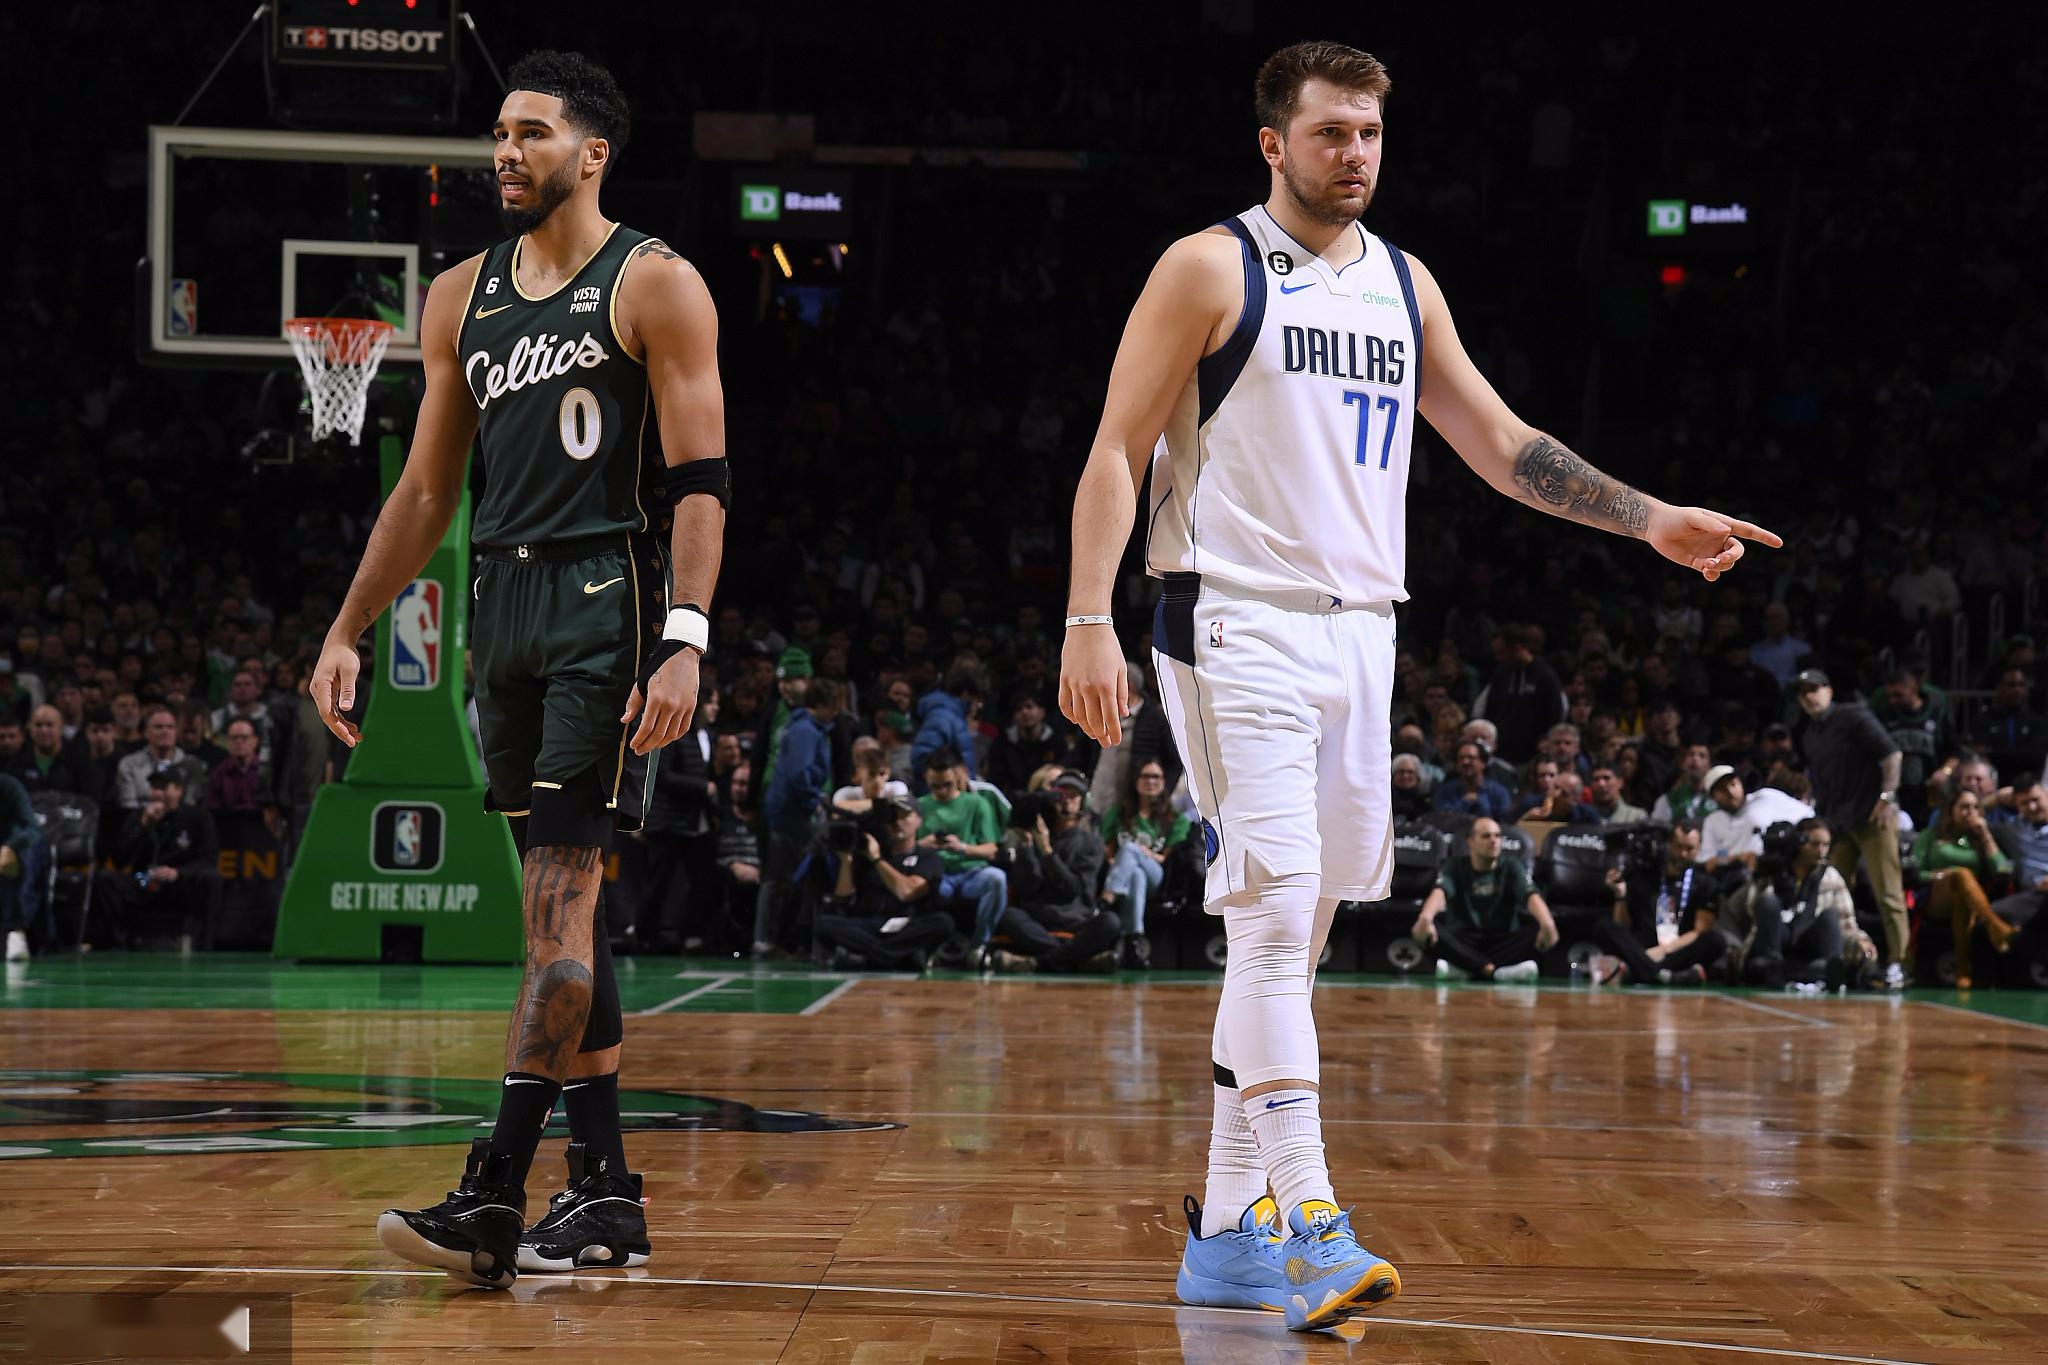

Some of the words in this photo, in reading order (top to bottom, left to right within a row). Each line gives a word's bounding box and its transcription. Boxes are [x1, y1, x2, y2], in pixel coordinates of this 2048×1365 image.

[328, 27, 444, 53] TISSOT
[746, 190, 778, 214] TD
[784, 191, 842, 212] Bank
[1651, 205, 1682, 229] TD
[1690, 203, 1747, 224] Bank
[1273, 256, 1287, 273] 6
[485, 277, 500, 294] 6
[573, 286, 600, 302] VISTA
[1362, 290, 1400, 307] chime
[570, 301, 599, 314] PRINT
[1281, 324, 1405, 387] DALLAS
[466, 331, 610, 411] Celtics
[559, 386, 603, 461] 0
[1342, 388, 1400, 471] 77
[331, 882, 364, 911] GET
[367, 882, 400, 912] THE
[403, 883, 443, 912] NEW
[443, 884, 479, 912] APP
